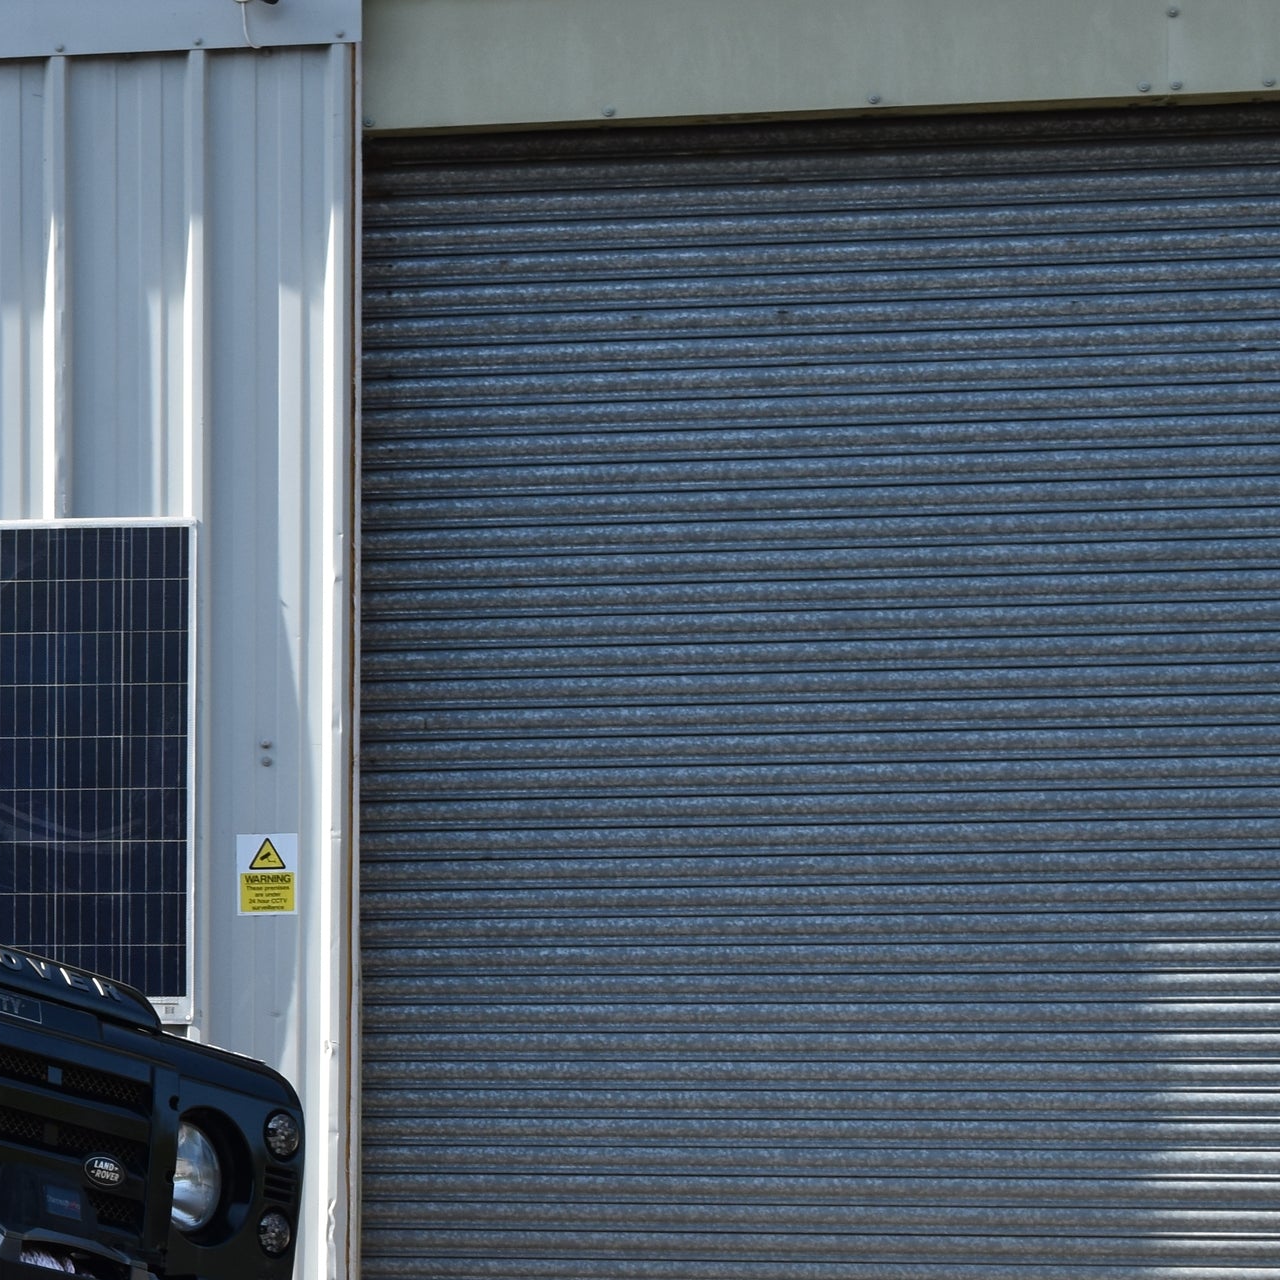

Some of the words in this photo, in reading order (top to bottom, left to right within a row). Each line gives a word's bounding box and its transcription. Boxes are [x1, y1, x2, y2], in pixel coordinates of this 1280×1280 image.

[244, 874, 292, 883] WARNING
[93, 1159, 115, 1172] LAND
[94, 1169, 120, 1182] ROVER
